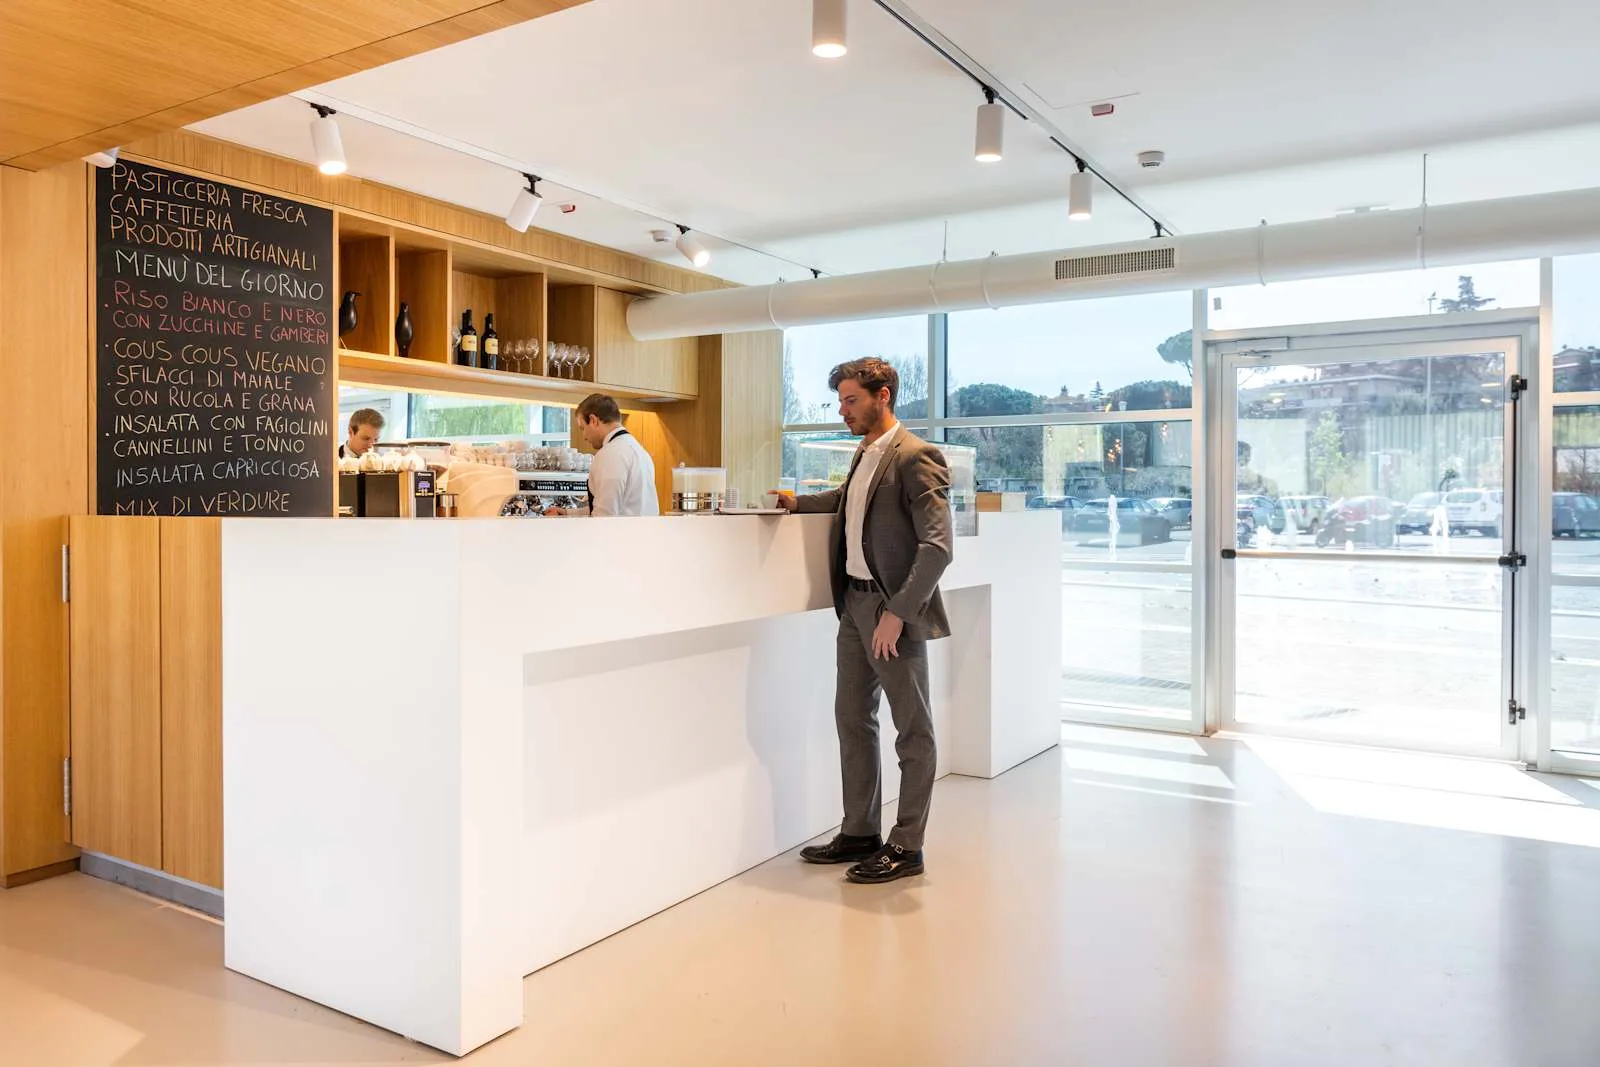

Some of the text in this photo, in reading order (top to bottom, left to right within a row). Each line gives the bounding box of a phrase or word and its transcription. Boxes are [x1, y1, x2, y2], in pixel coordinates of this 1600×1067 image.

[111, 163, 307, 227] PASTICCERIA FRESCA
[110, 194, 233, 232] CAFFETTERIA
[110, 215, 317, 271] PRODOTTI ARTIGIANALI
[116, 250, 323, 301] MENÙ DEL GIORNO
[114, 281, 327, 326] RISO BIANCO E NERO
[113, 311, 329, 345] CON ZUCCHINE E GAMBERI
[114, 338, 326, 375] COUS COUS VEGANO
[116, 365, 293, 391] SFILACCI DI MAIALE
[114, 387, 315, 413] CON RUCOLA E GRANA
[114, 413, 327, 436] INSALATA CON FAGIOLINI
[114, 434, 305, 457] CANNELLINI E TONNO
[116, 458, 320, 488] INSALATA CAPRICCIOSA
[116, 490, 290, 516] MIX DI VERDURE
